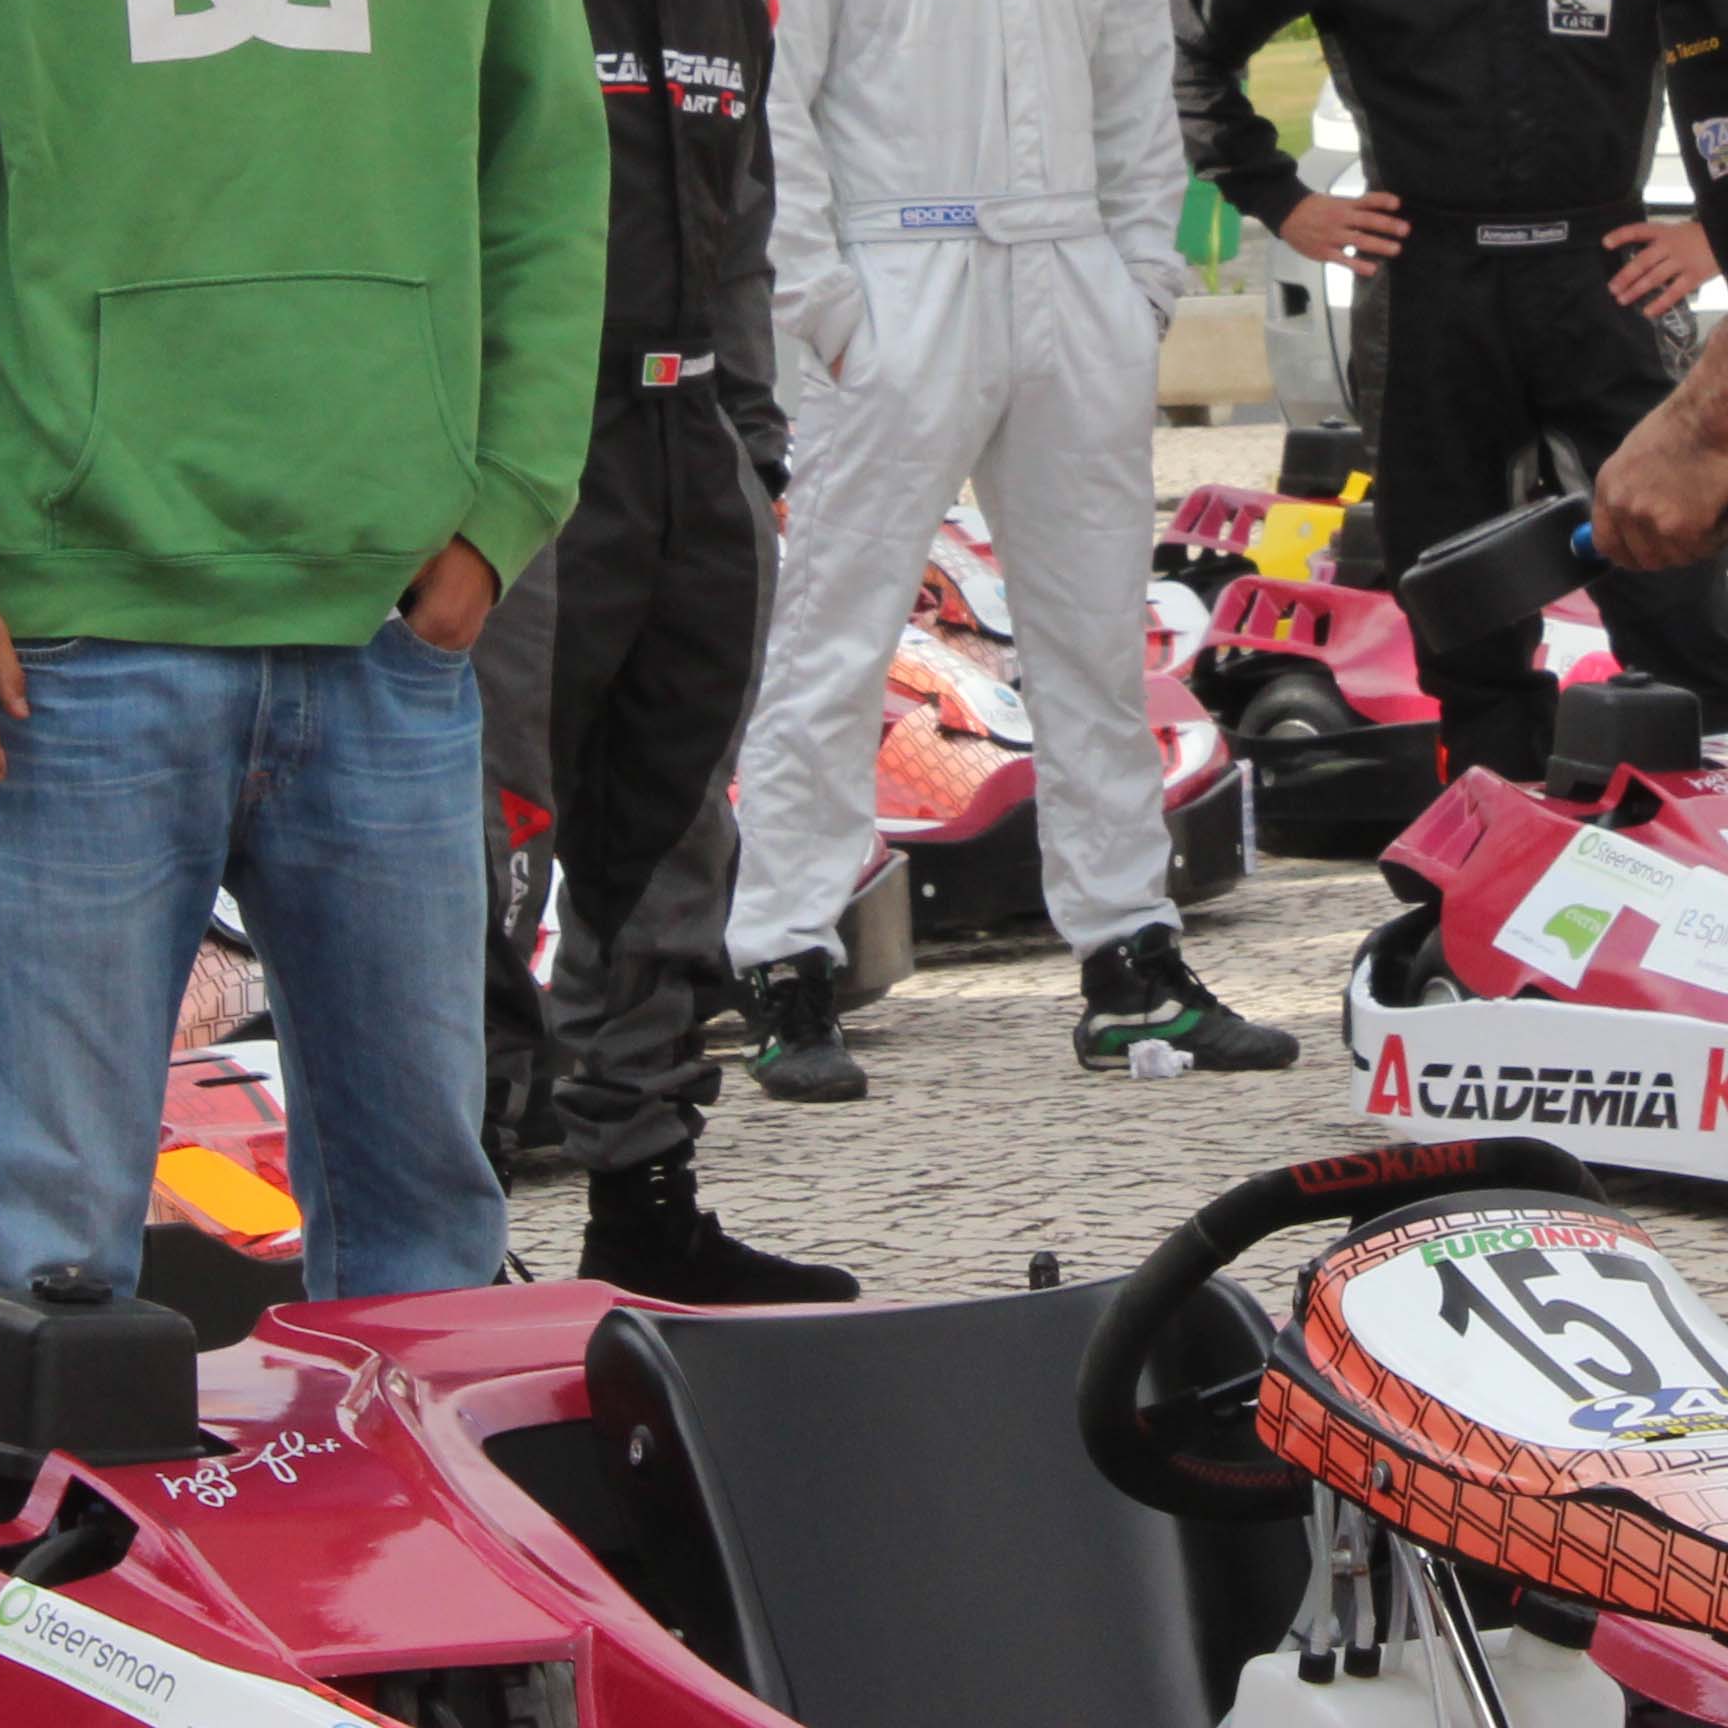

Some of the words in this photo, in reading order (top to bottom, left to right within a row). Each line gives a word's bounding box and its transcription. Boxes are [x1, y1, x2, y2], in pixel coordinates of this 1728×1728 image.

[901, 206, 976, 227] sparco
[1594, 840, 1675, 896] Steersman
[1366, 1033, 1679, 1130] ACADEMIA
[1422, 1226, 1619, 1266] EUROINDY
[25, 1602, 176, 1703] Steersman
